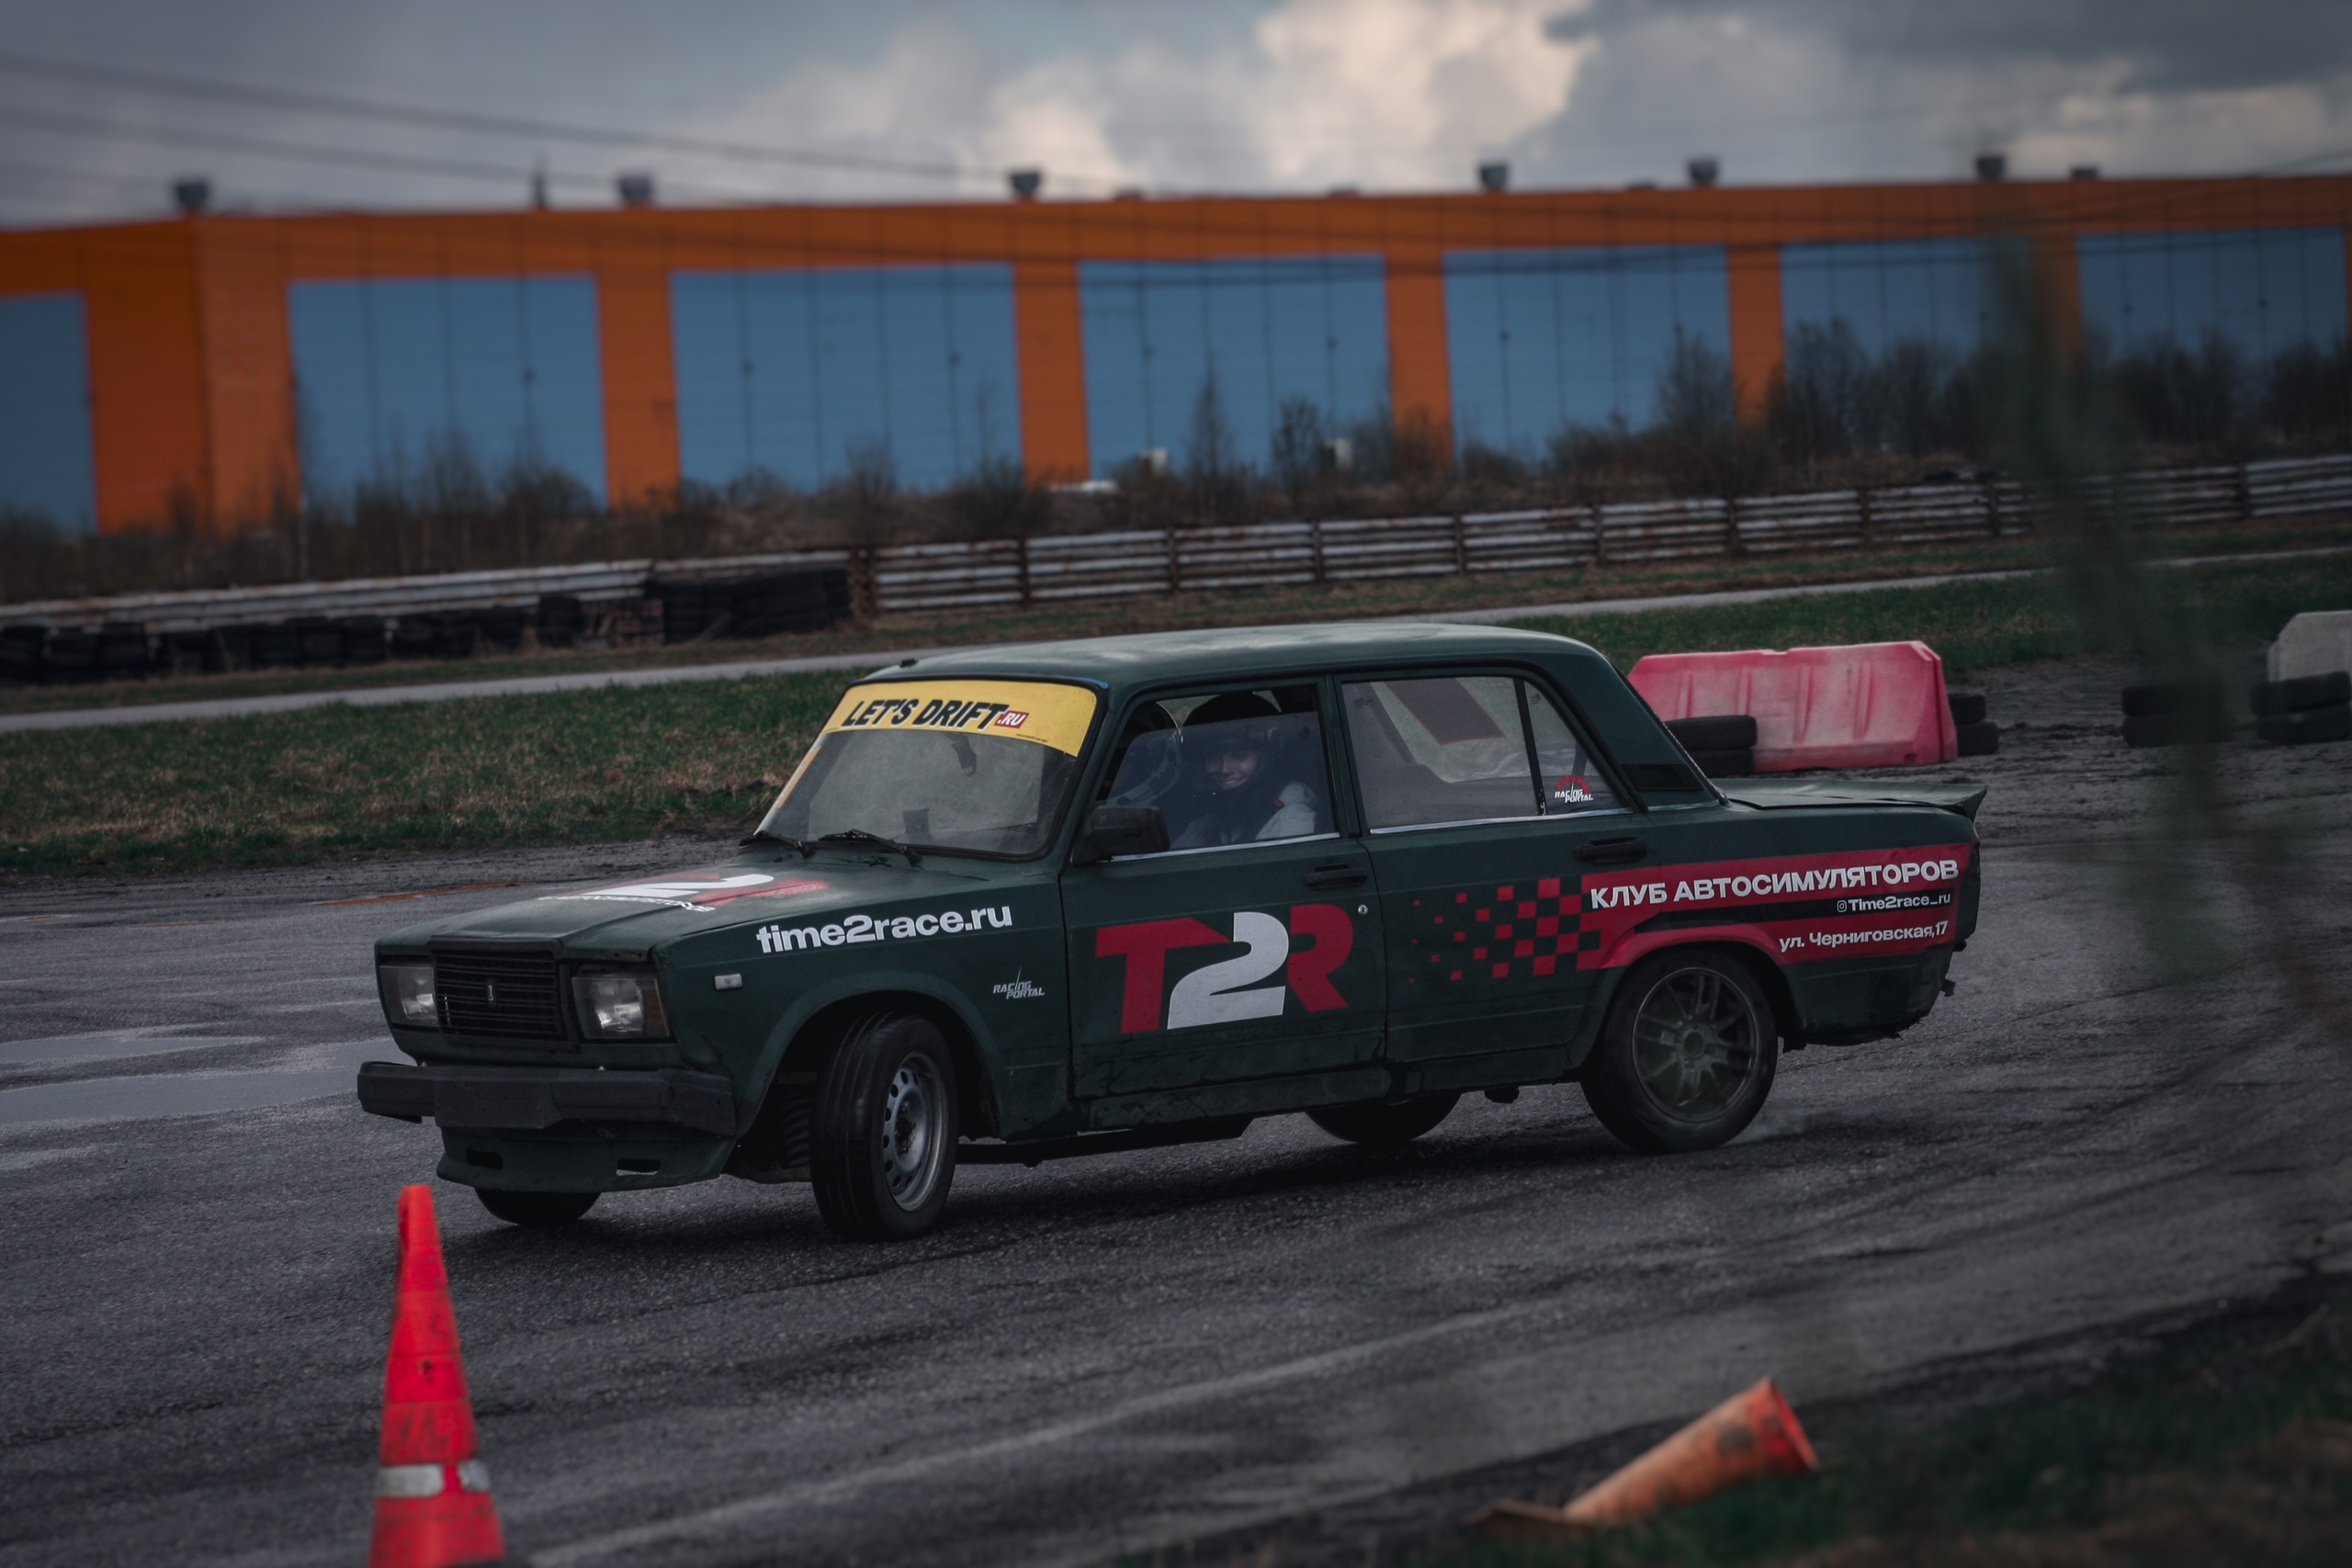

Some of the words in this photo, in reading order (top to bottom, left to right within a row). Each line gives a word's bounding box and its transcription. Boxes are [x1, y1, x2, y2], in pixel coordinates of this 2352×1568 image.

[841, 698, 920, 728] LET'S
[1555, 784, 1583, 798] RACING
[1565, 794, 1593, 803] PORTAL
[1590, 882, 1668, 909] КЛУБ
[1674, 859, 1960, 902] АВТОСИМУЛЯТОРОВ
[1848, 894, 1951, 912] Time2race_ru
[756, 905, 1013, 953] time2race.ru
[1779, 936, 1805, 953] ул.
[1094, 903, 1354, 1034] T2R
[993, 973, 1032, 994] RACING
[1005, 987, 1046, 1000] PORTAL
